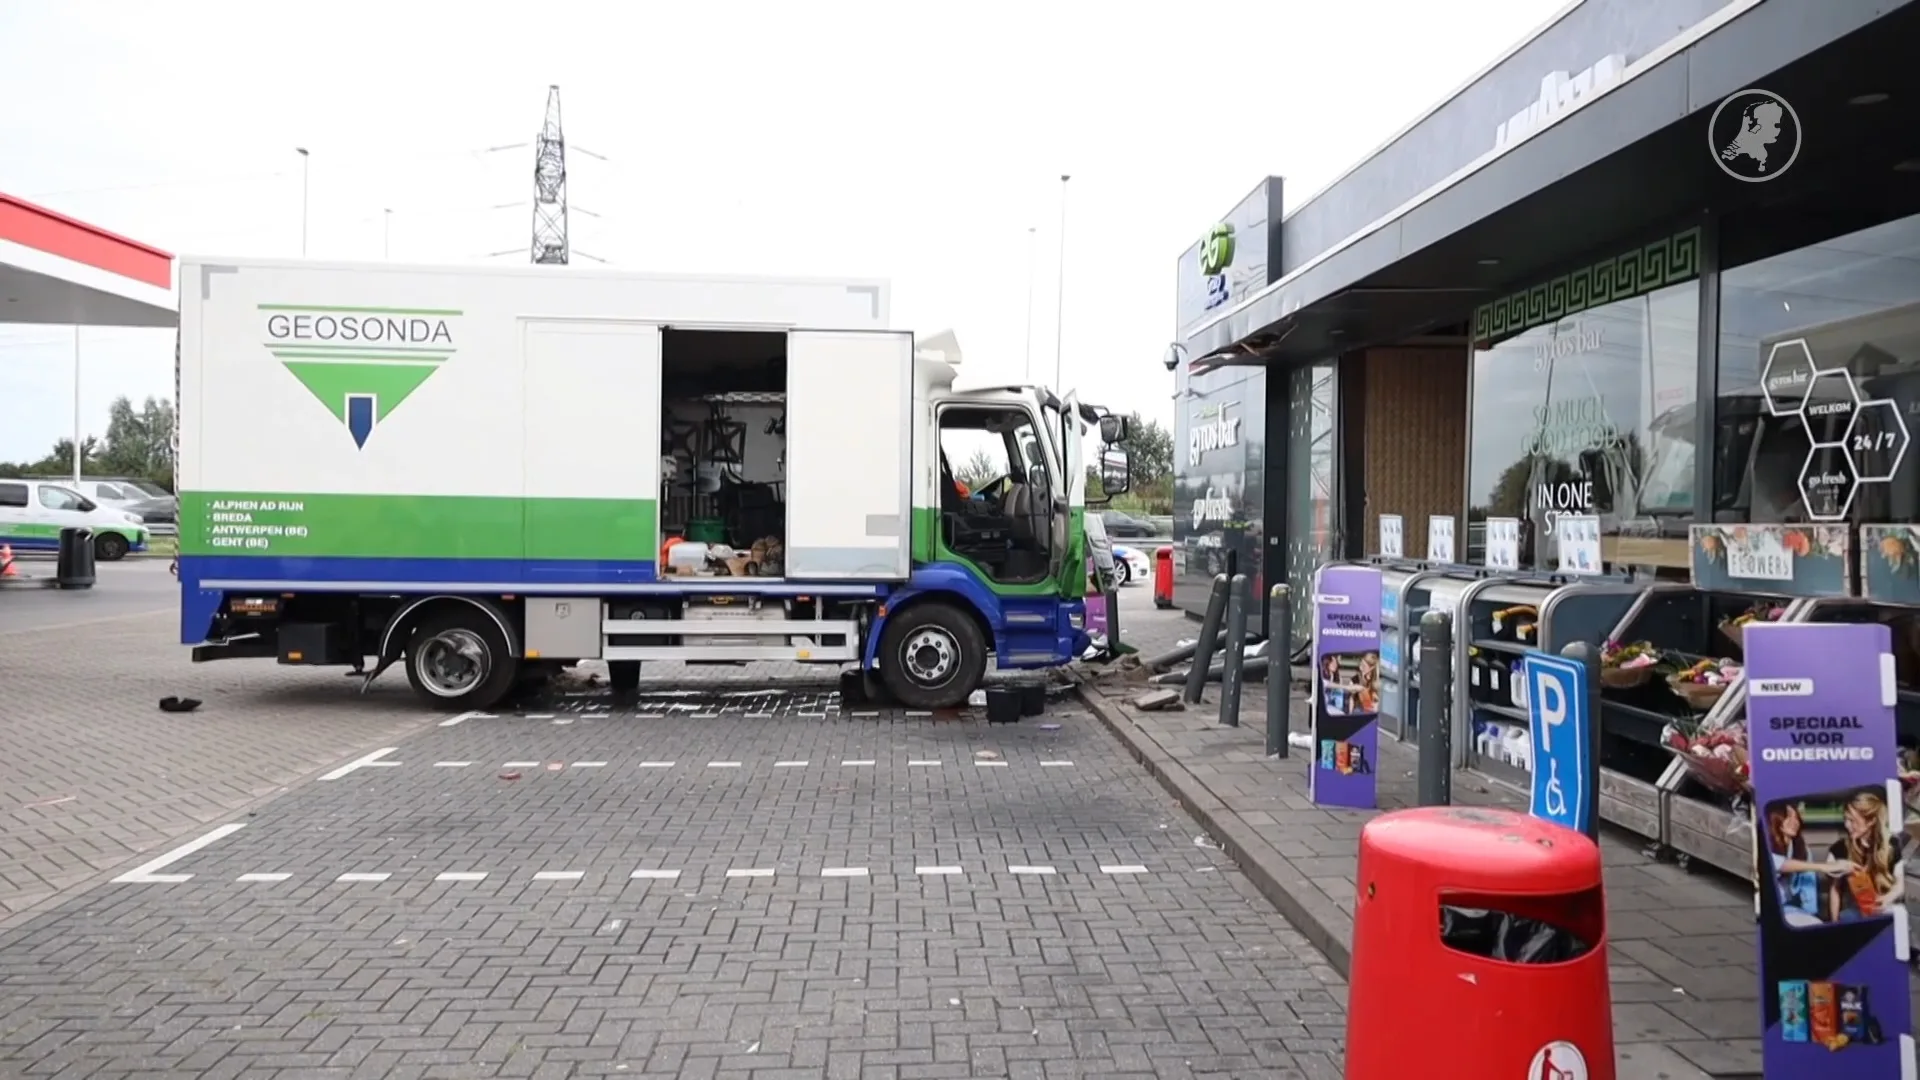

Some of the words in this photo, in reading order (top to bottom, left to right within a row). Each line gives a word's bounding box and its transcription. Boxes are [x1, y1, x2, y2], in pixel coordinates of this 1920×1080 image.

[268, 314, 453, 344] GEOSONDA
[1809, 402, 1851, 416] WELKOM
[1218, 402, 1241, 449] bar
[1808, 477, 1821, 488] go
[1821, 471, 1846, 485] fresh
[1537, 483, 1554, 509] IN
[1557, 481, 1593, 508] ONE
[212, 501, 258, 510] ALPHEN
[259, 502, 276, 511] AD
[278, 502, 304, 511] RIJN
[212, 513, 253, 522] BREDA
[212, 525, 283, 535] ANTWERPEN
[284, 527, 308, 537] (BE)
[212, 538, 243, 547] GENT
[245, 538, 269, 549] (BE)
[1731, 553, 1790, 576] FLOWERS
[1327, 613, 1372, 622] SPECIAAL
[1336, 621, 1363, 630] VOOR
[1322, 628, 1377, 638] ONDERWEG
[1760, 682, 1802, 692] NIEUW
[1536, 671, 1567, 752] P
[1769, 715, 1864, 730] SPECIAAL
[1790, 731, 1844, 745] VOOR
[1761, 747, 1874, 761] ONDERWEG
